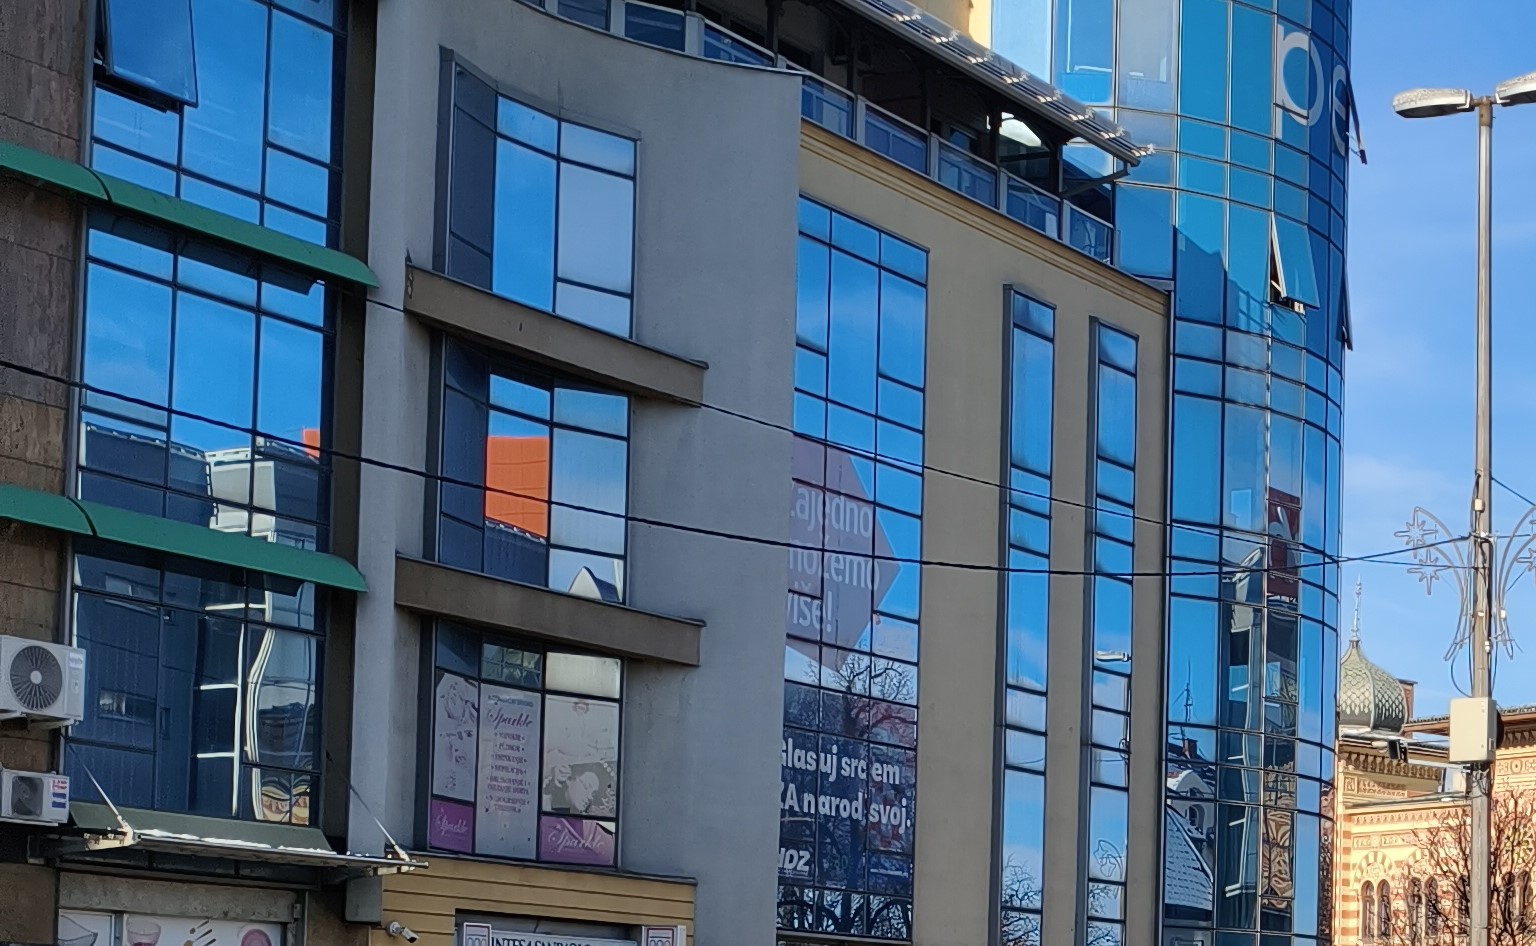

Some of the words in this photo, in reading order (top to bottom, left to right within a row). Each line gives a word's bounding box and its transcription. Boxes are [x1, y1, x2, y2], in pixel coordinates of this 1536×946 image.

[790, 482, 872, 538] ajedno
[841, 756, 900, 785] srcem
[803, 791, 863, 821] narod
[868, 798, 911, 834] svoj.
